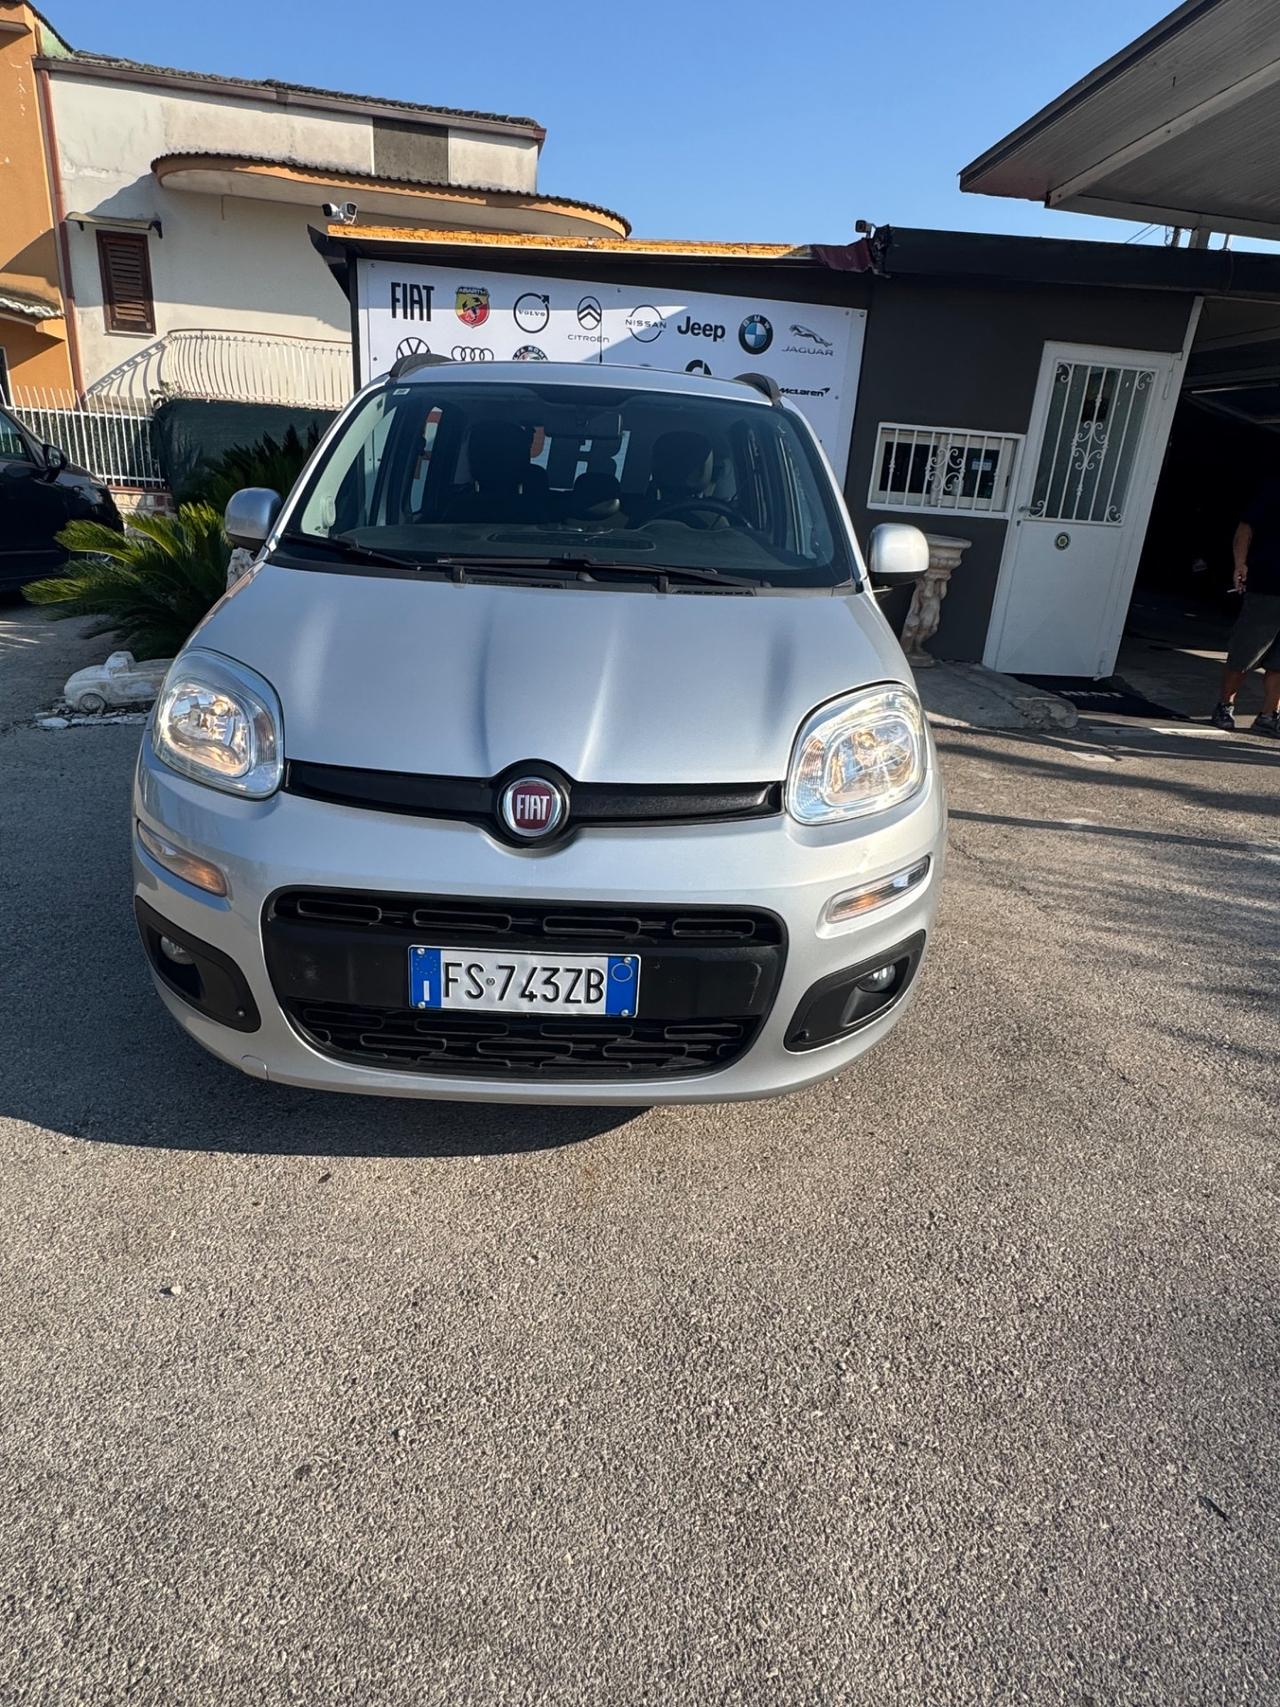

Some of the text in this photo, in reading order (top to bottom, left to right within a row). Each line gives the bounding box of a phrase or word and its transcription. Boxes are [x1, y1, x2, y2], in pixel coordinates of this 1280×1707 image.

[390, 282, 434, 322] FIAT
[625, 319, 667, 329] NISSAN
[677, 316, 726, 342] Jeep
[781, 346, 834, 356] JAGUAR
[779, 387, 824, 397] McLaren
[516, 794, 550, 820] FIAT
